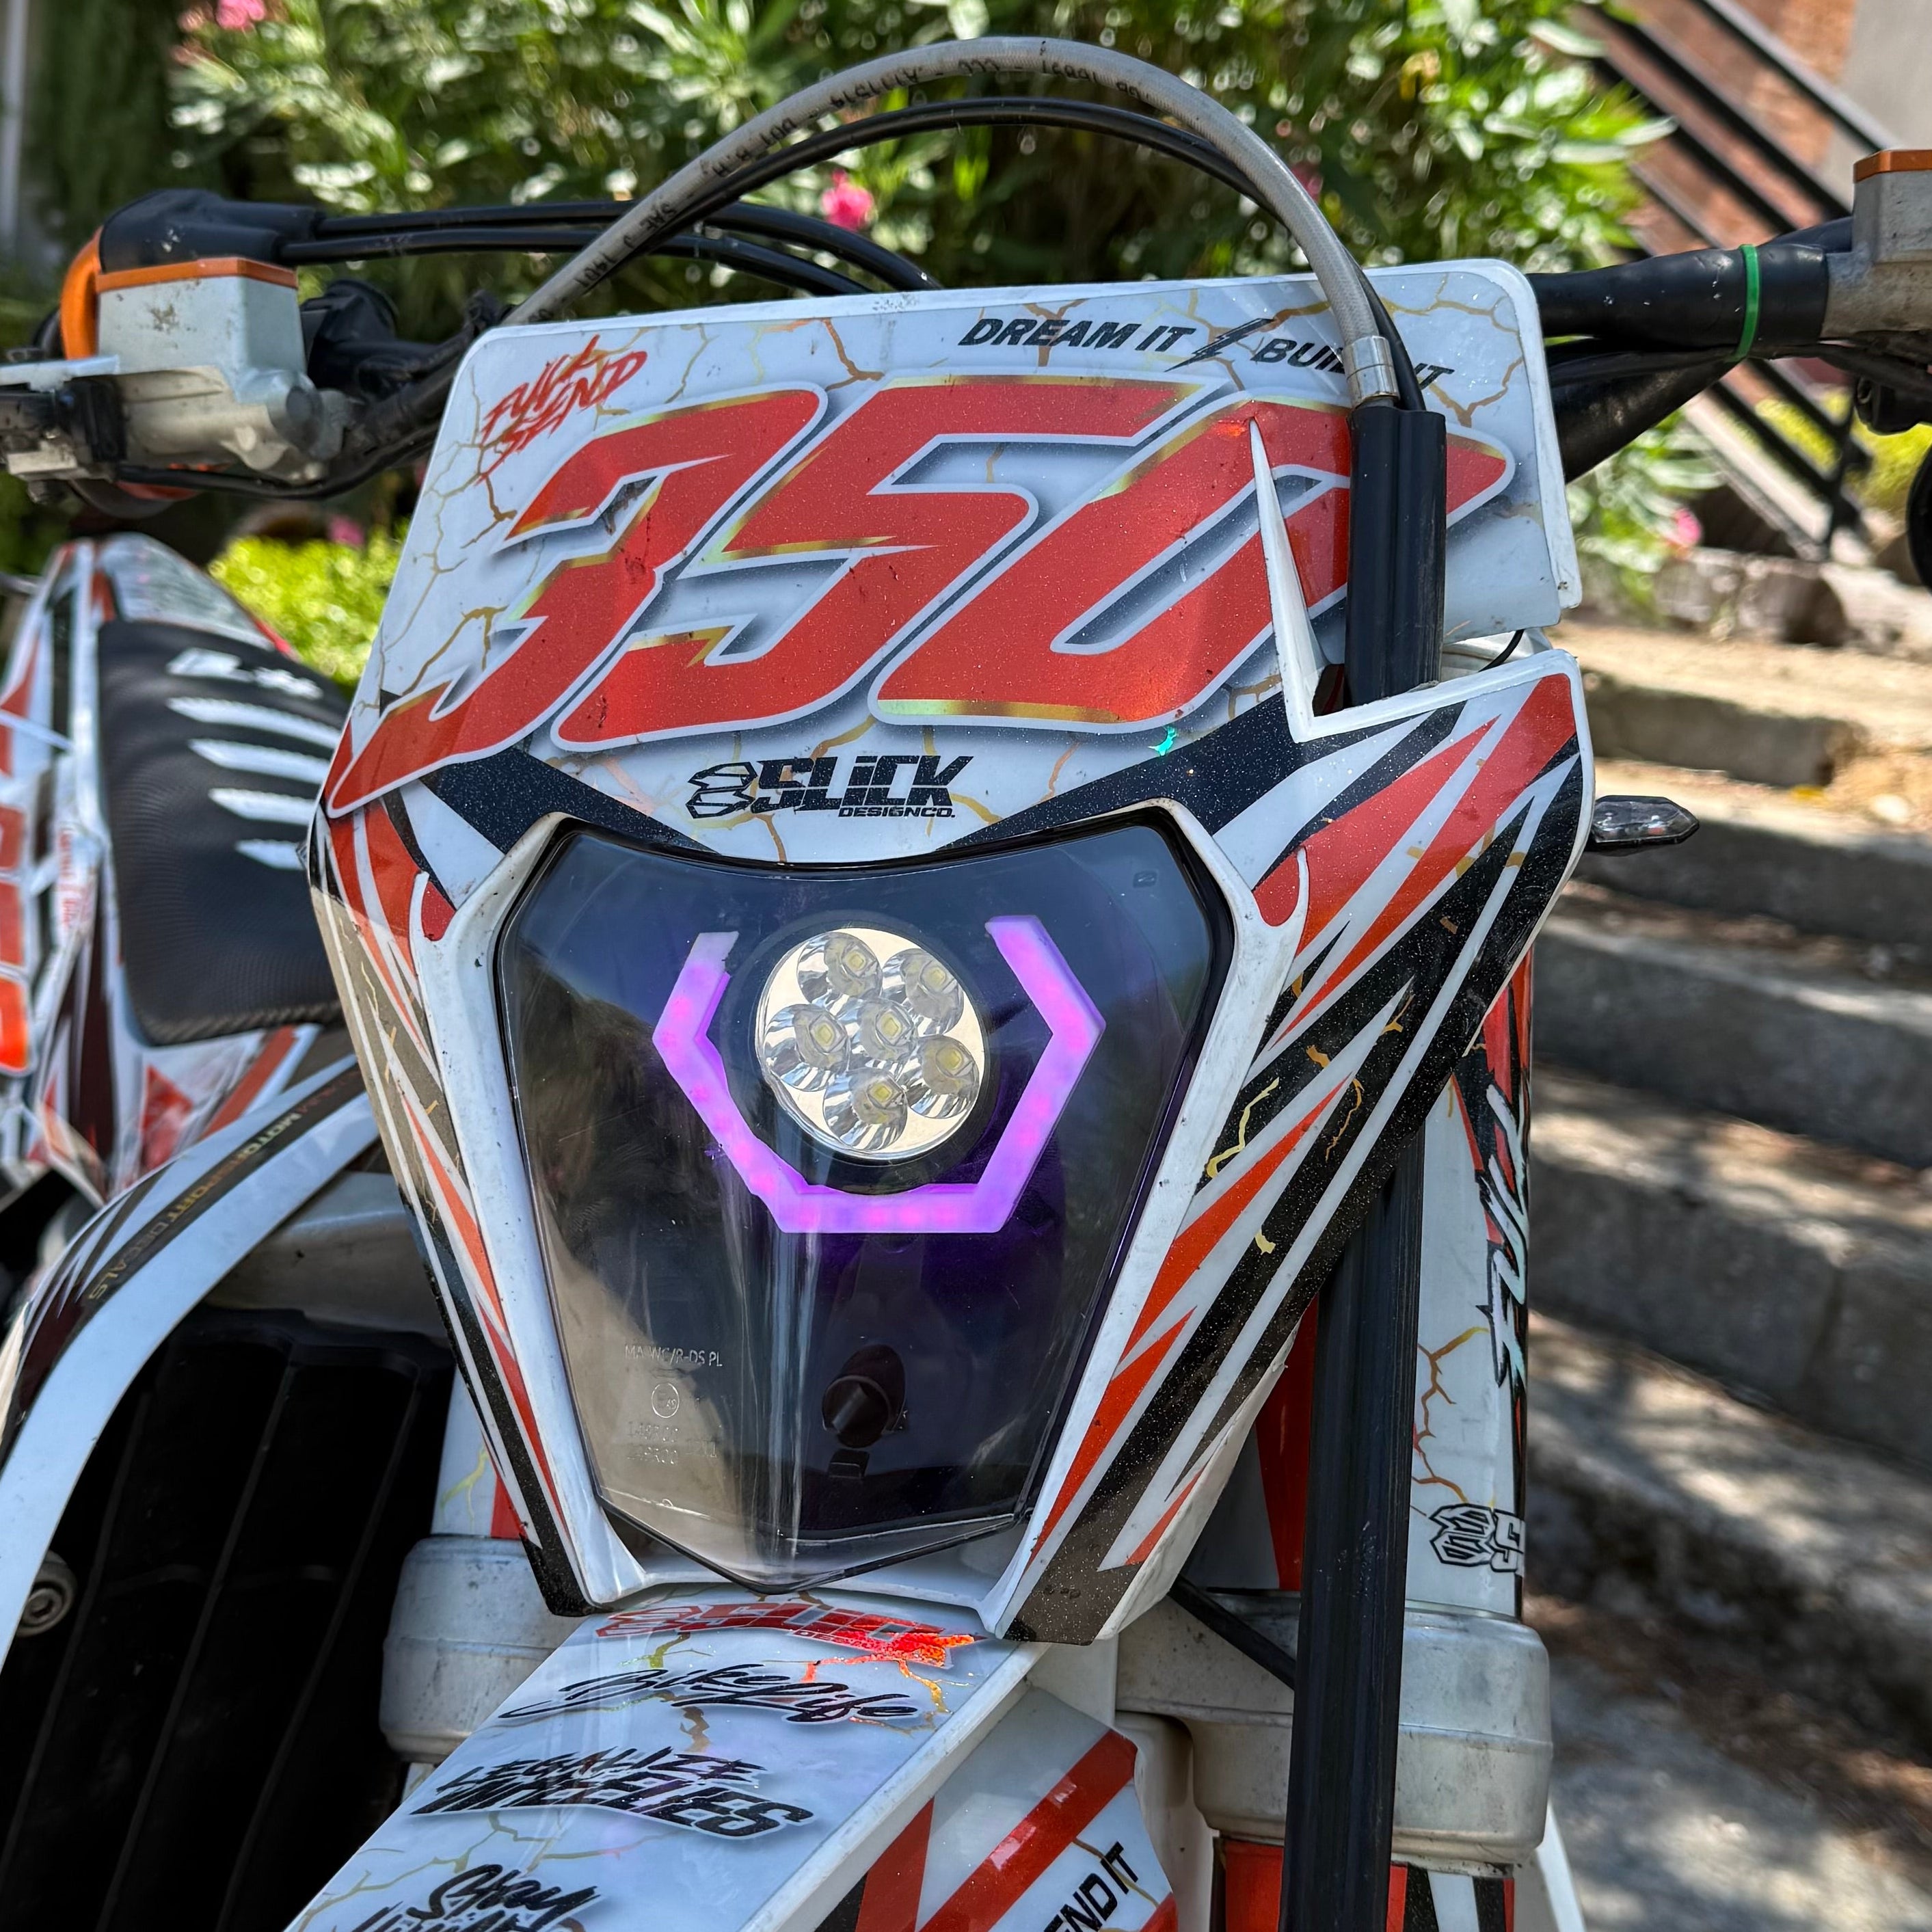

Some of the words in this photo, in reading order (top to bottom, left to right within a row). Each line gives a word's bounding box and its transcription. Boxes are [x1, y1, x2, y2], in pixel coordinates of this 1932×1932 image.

[957, 319, 1142, 350] DREAM
[1134, 325, 1196, 352] IT
[331, 373, 1514, 811] 350
[708, 1351, 723, 1367] PL
[498, 1663, 790, 1719] Bike
[672, 1682, 918, 1723] Life
[1100, 1840, 1139, 1895] IT
